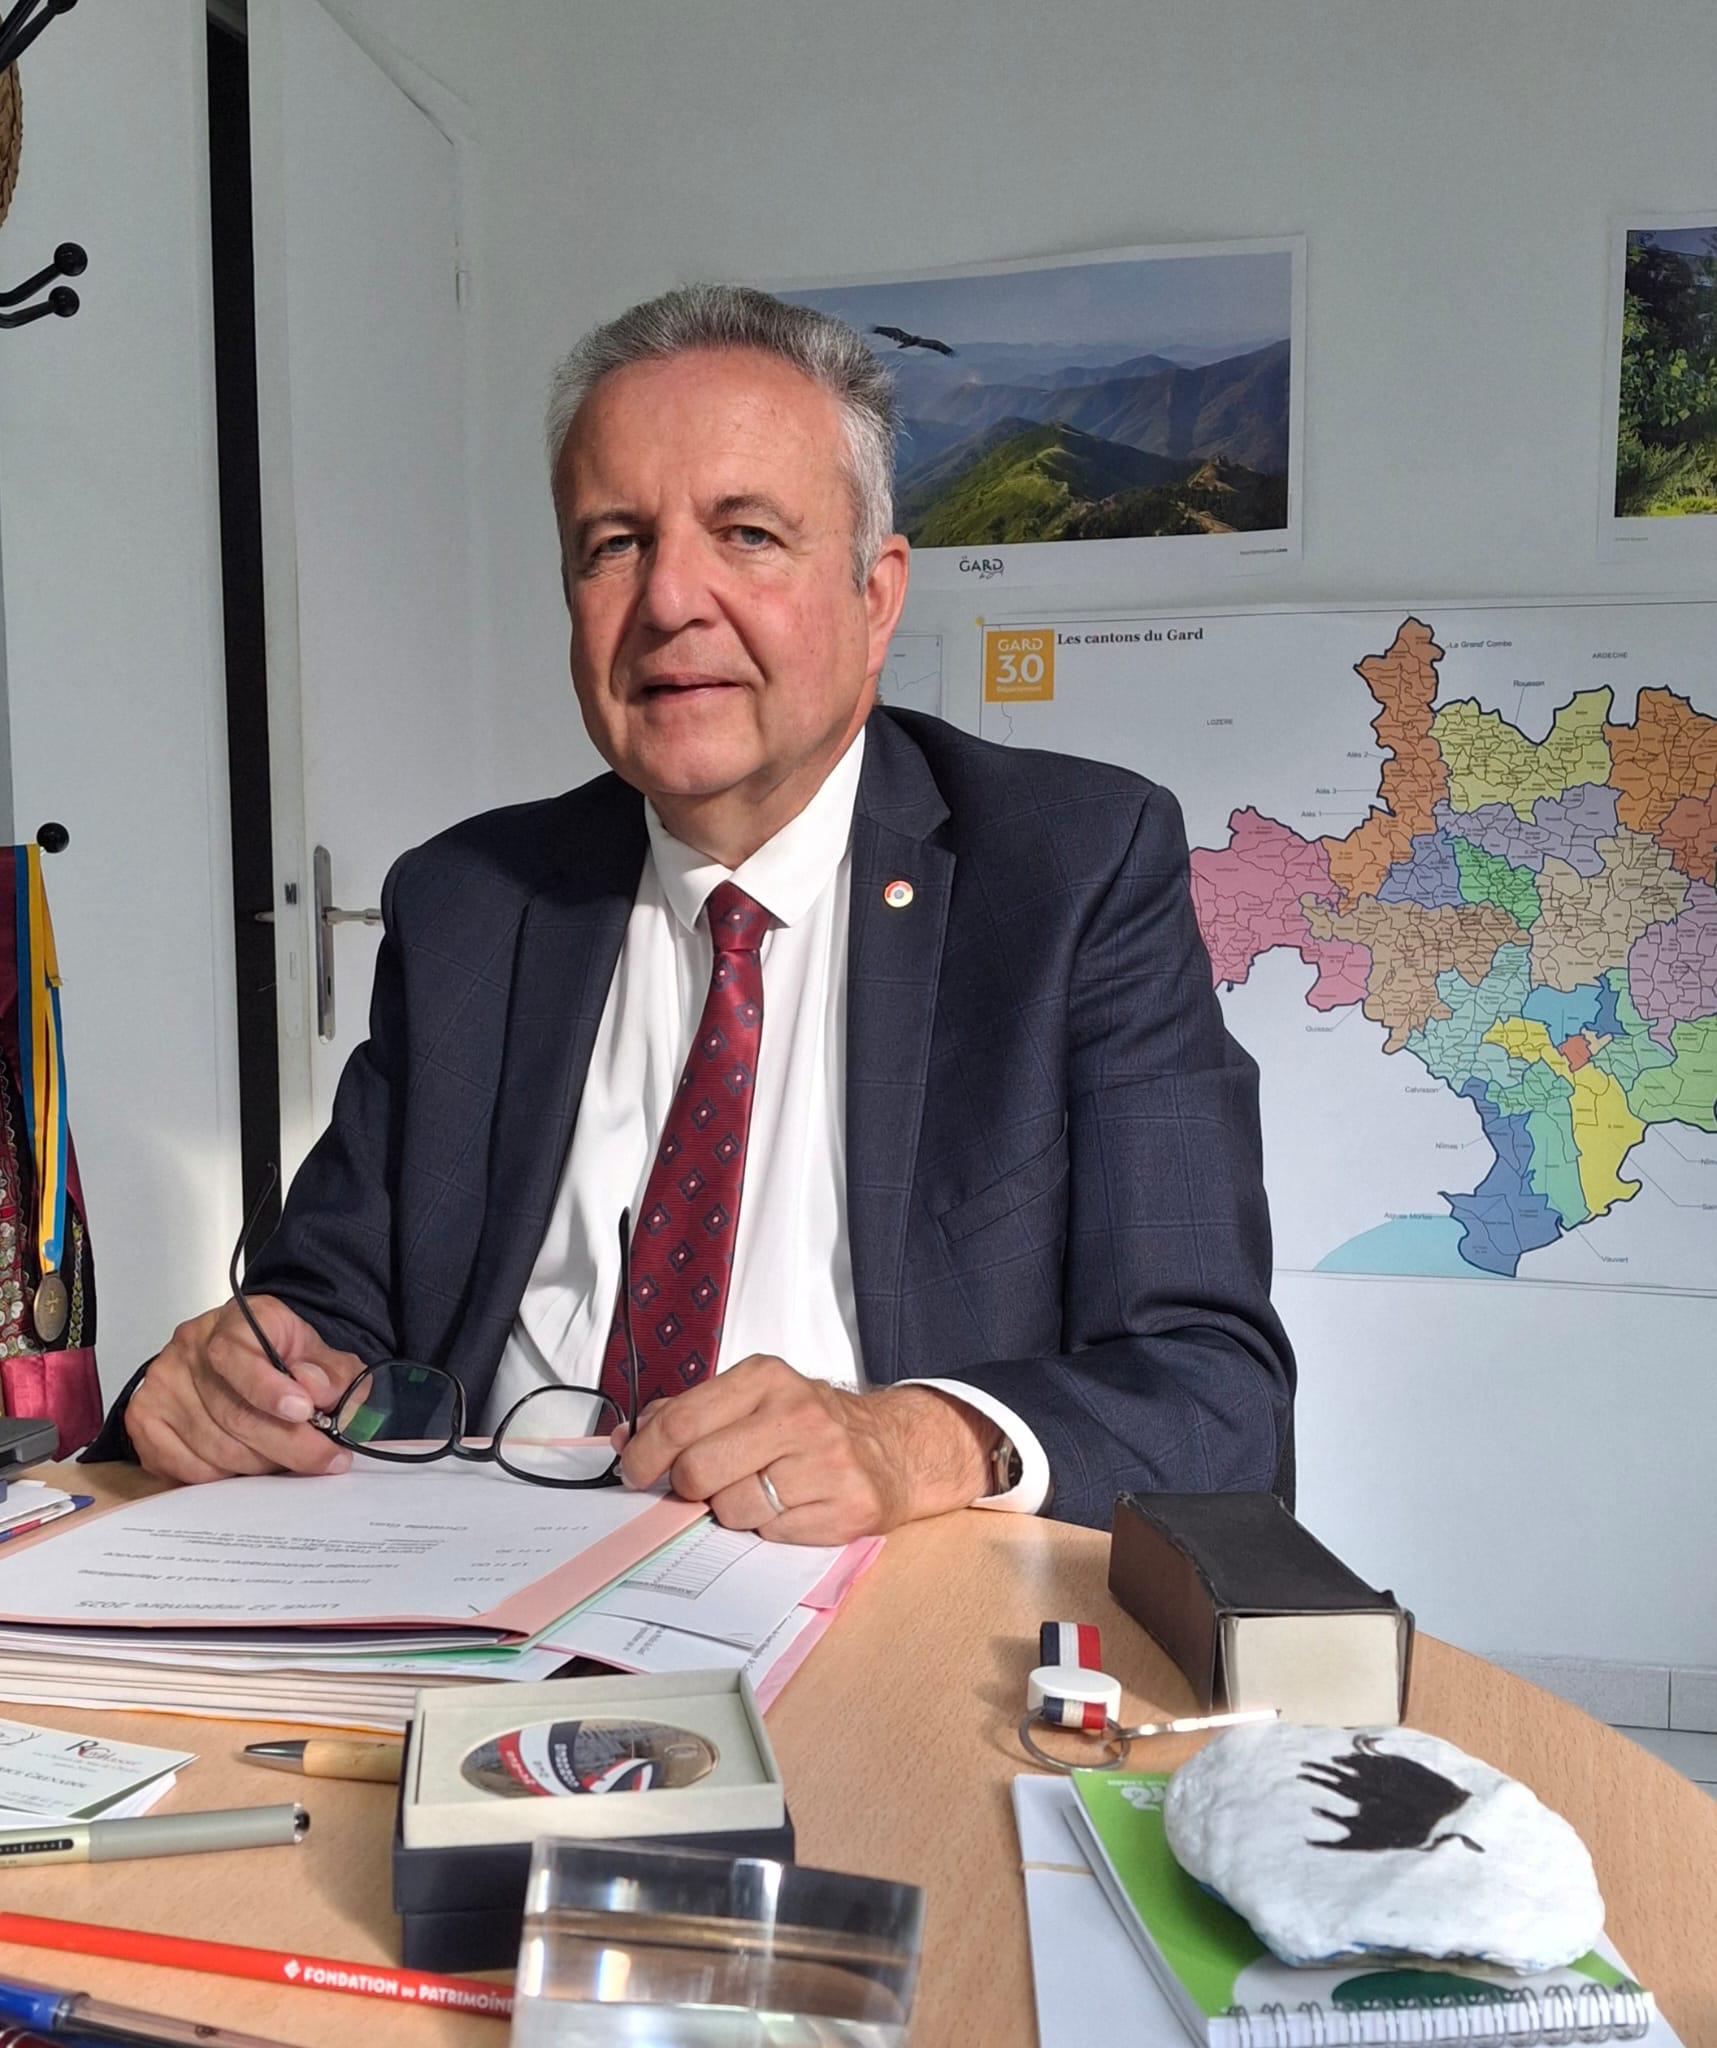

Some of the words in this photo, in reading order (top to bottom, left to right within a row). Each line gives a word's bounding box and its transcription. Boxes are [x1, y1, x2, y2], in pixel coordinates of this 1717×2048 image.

[959, 558, 1004, 573] GARD
[998, 638, 1043, 651] GARD
[1057, 633, 1081, 645] Les
[1084, 632, 1141, 644] cantons
[1144, 629, 1163, 641] du
[1166, 627, 1204, 641] Gard
[996, 653, 1044, 683] 3.0
[304, 1966, 398, 1997] FONDATION
